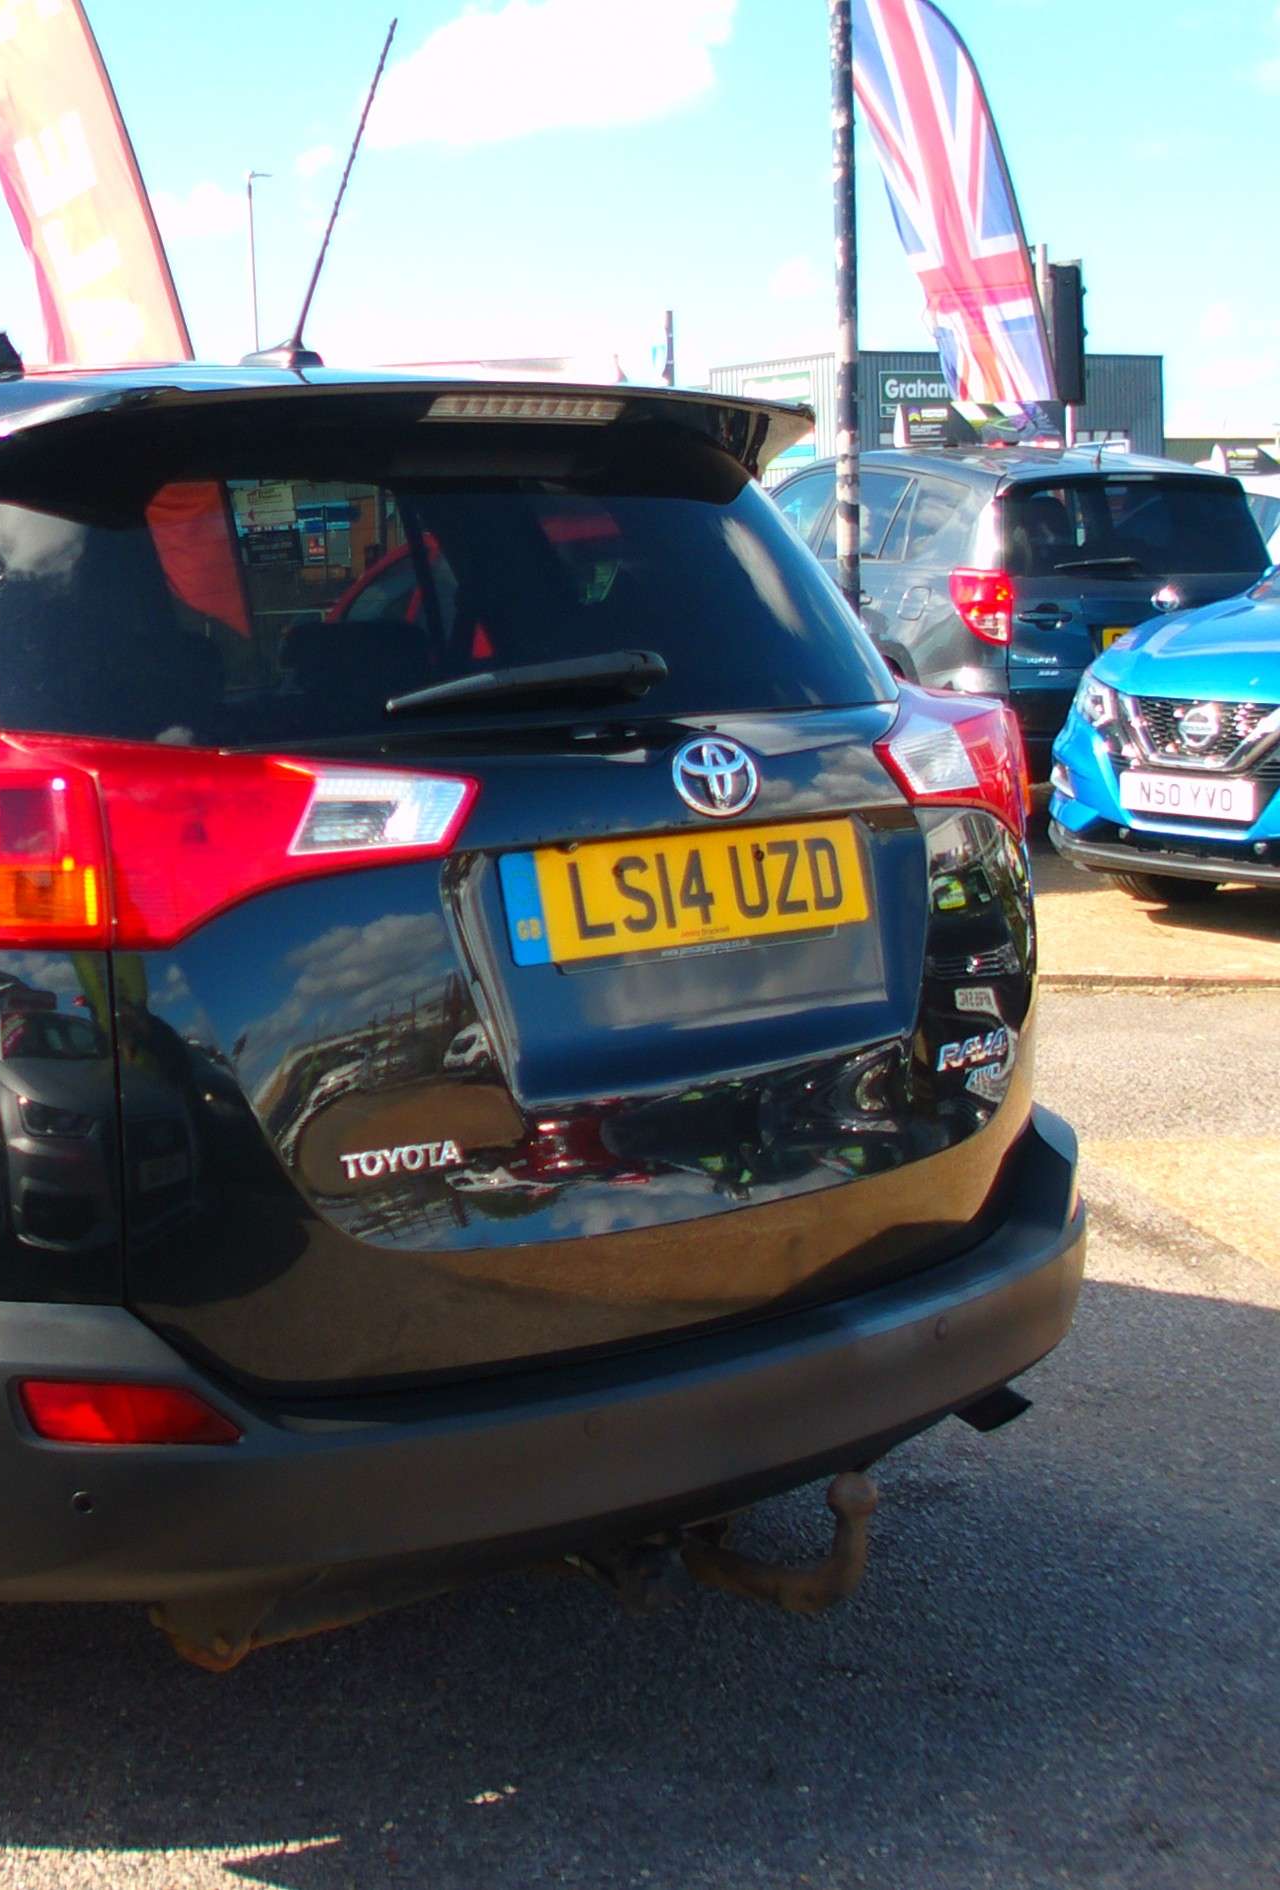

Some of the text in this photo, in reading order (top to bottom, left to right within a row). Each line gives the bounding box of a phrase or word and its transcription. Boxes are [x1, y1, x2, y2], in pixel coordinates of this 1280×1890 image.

[567, 837, 843, 941] LS14 UZD
[515, 917, 543, 943] GB
[936, 1027, 1008, 1072] RAV4
[339, 1140, 462, 1179] TOYOTA
